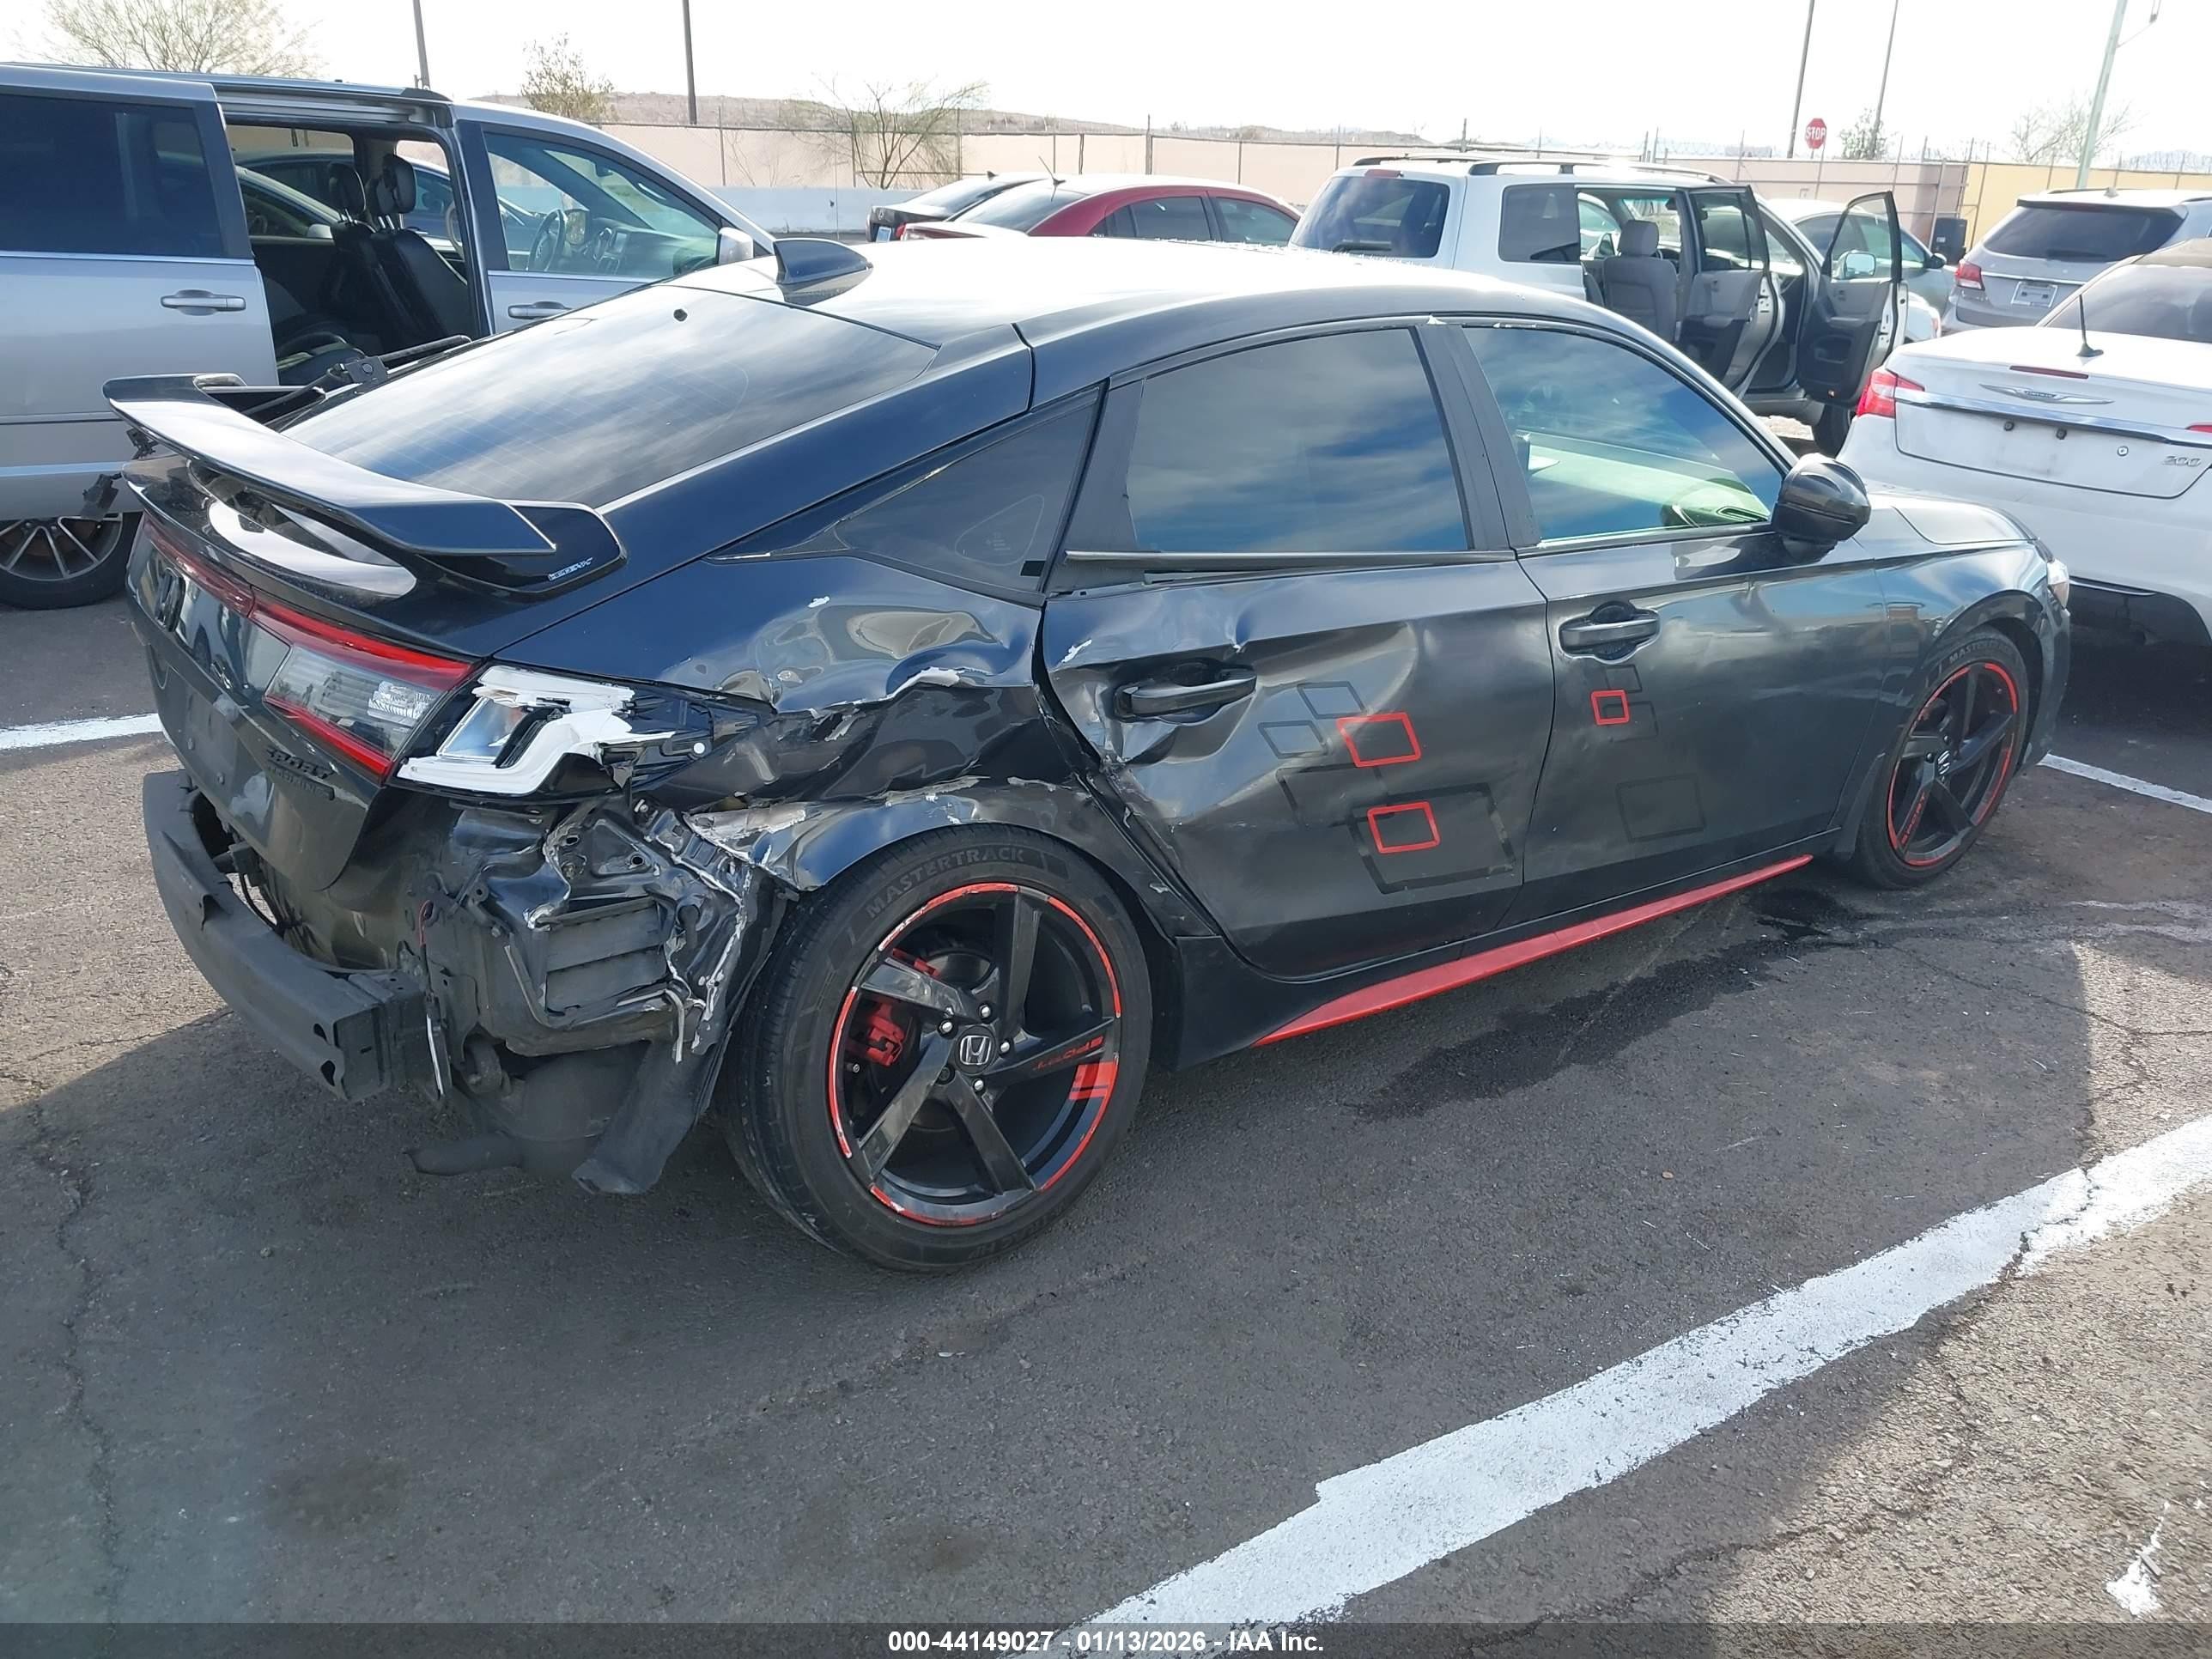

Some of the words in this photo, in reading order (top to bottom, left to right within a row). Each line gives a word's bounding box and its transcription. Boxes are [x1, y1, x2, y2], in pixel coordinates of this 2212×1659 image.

[1806, 126, 1826, 140] STOP
[2163, 455, 2201, 467] 200
[865, 847, 1024, 919] MASTERTRACK
